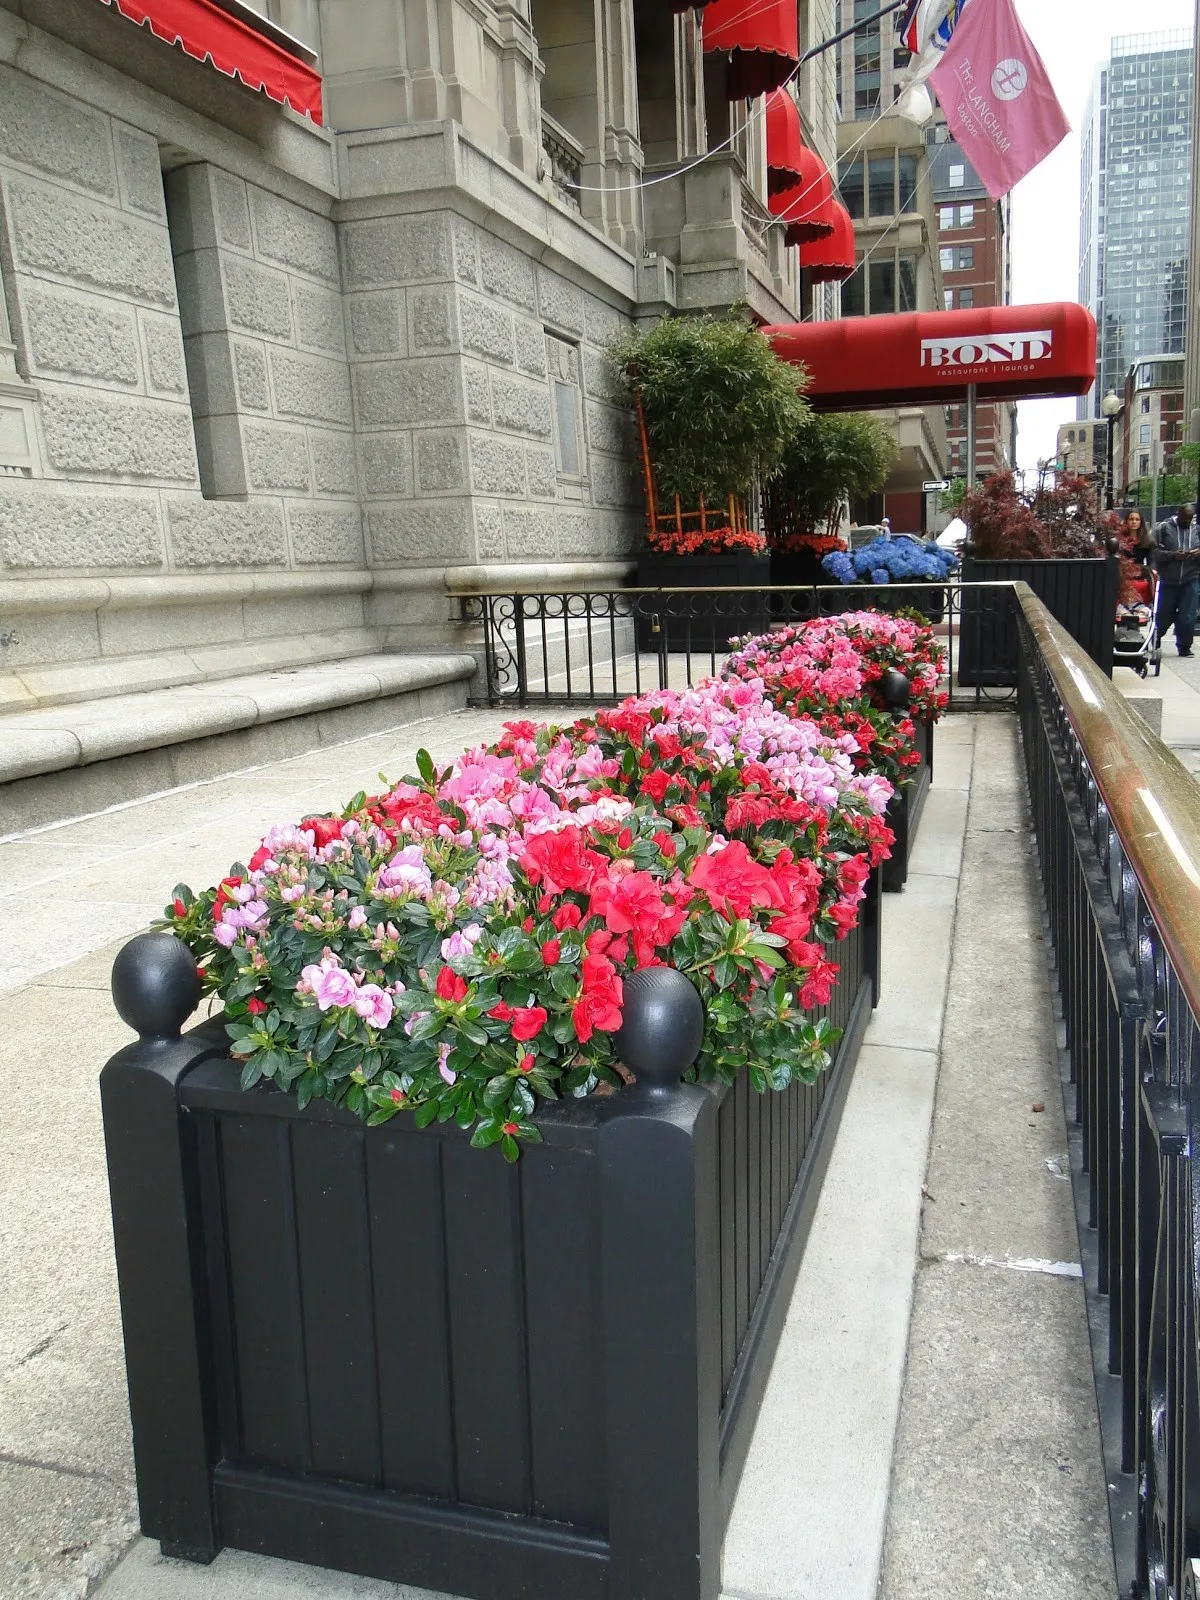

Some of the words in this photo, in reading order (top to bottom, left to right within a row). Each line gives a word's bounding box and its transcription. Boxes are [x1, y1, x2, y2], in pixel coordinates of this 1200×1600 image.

[957, 103, 978, 137] Boston
[960, 58, 974, 85] THE
[968, 87, 1011, 153] LANGHAM
[921, 338, 1052, 367] BOND
[937, 367, 988, 376] restaurant
[1001, 364, 1035, 372] lounge
